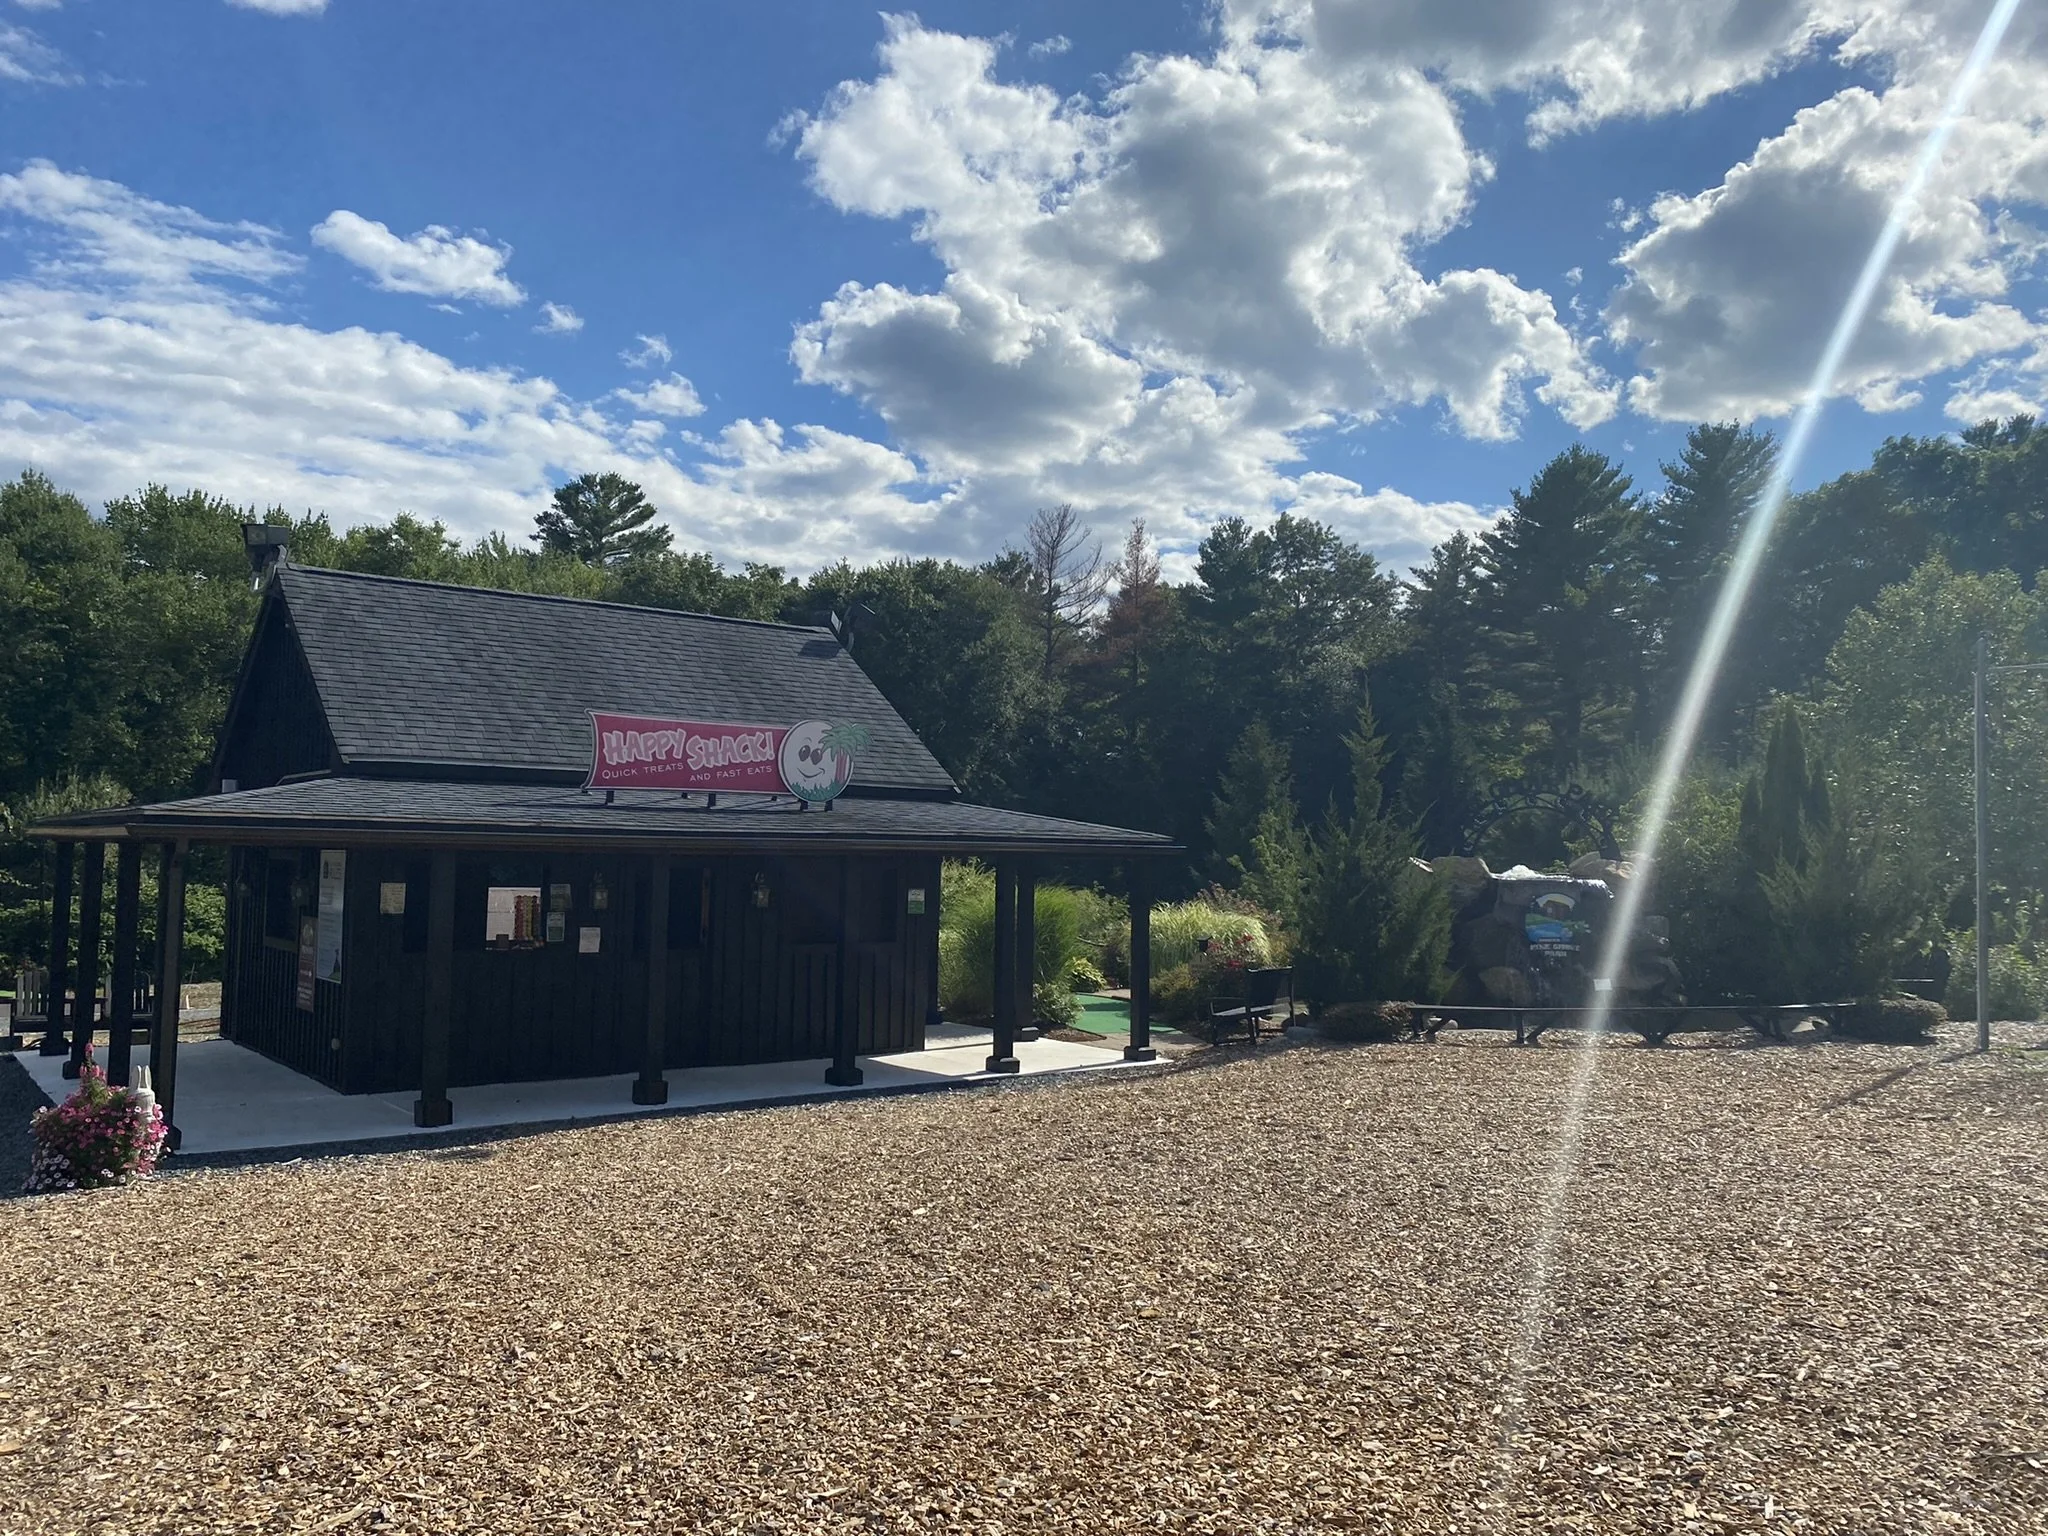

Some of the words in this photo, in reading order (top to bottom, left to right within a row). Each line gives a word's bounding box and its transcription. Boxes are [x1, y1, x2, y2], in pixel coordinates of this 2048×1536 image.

[602, 728, 686, 765] HAPPY
[686, 732, 775, 770] SHACK!
[602, 768, 638, 779] QUICK
[643, 763, 684, 774] TREATS
[689, 773, 711, 782] AND
[716, 769, 741, 779] FAST
[747, 766, 772, 775] EATS
